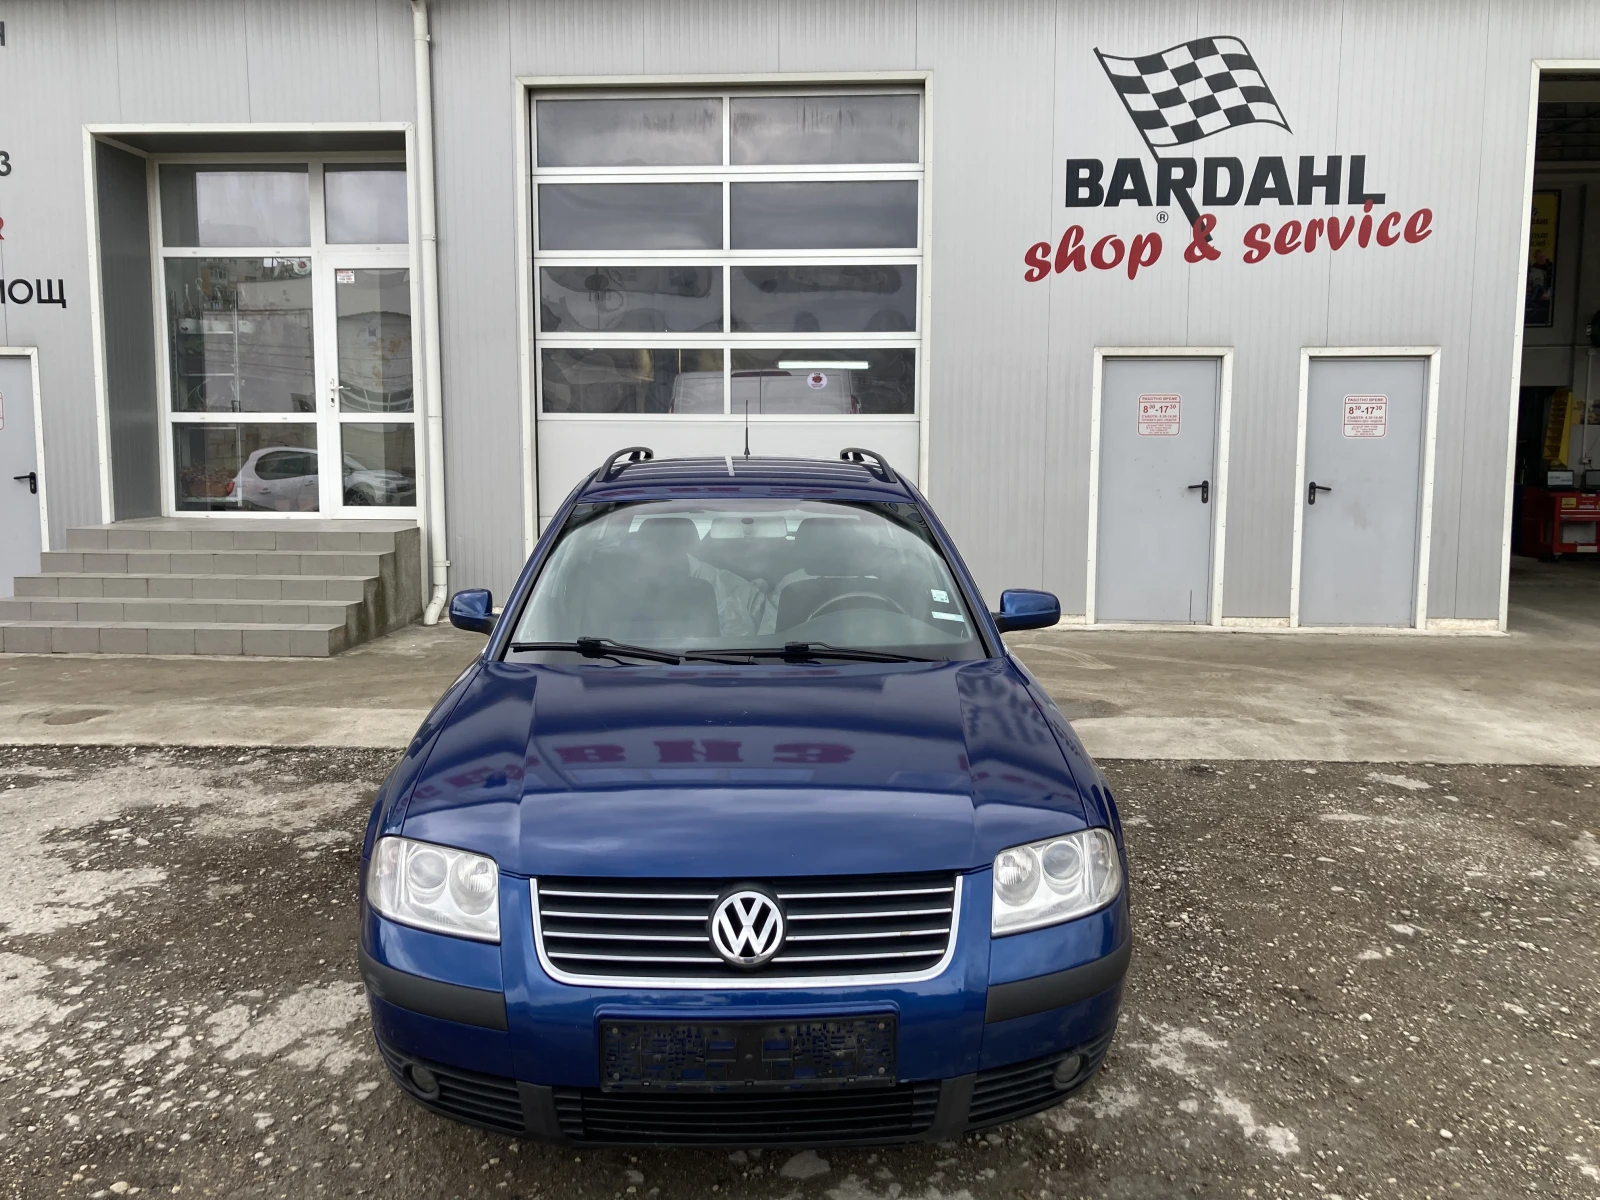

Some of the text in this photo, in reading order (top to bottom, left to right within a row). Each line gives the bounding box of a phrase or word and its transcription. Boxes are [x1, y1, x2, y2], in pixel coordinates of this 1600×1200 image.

[1065, 155, 1386, 209] BARDAHL
[1024, 199, 1432, 281] shop & service
